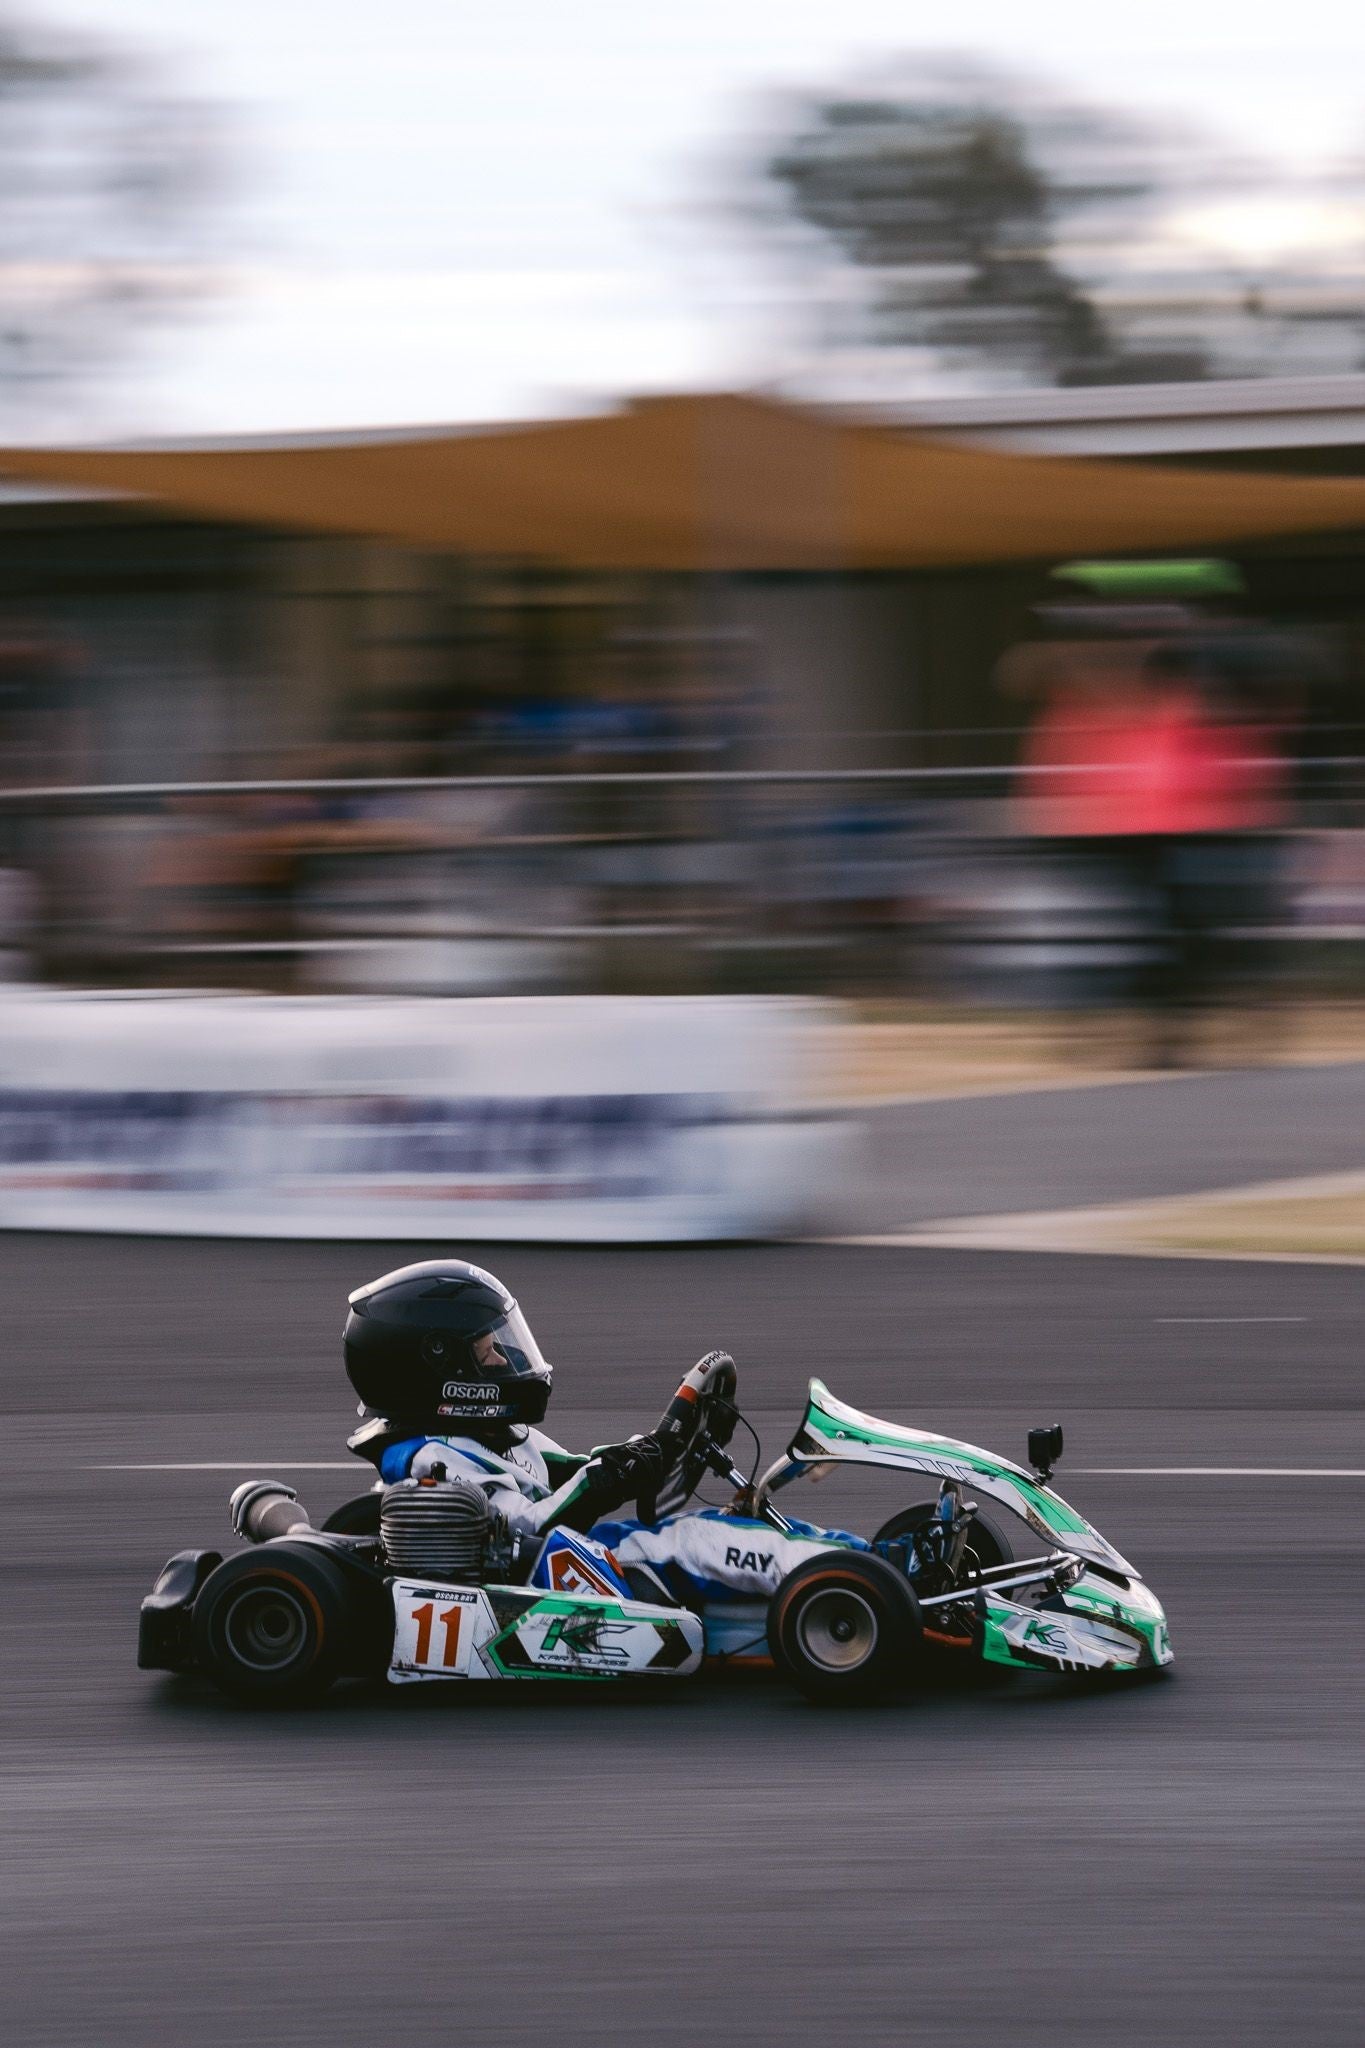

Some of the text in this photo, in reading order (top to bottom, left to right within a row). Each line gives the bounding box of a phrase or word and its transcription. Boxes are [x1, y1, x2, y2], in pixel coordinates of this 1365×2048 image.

[446, 1385, 496, 1400] OSCAR
[725, 1547, 774, 1573] RAY
[434, 1592, 460, 1601] OSCAR
[411, 1603, 462, 1668] 11
